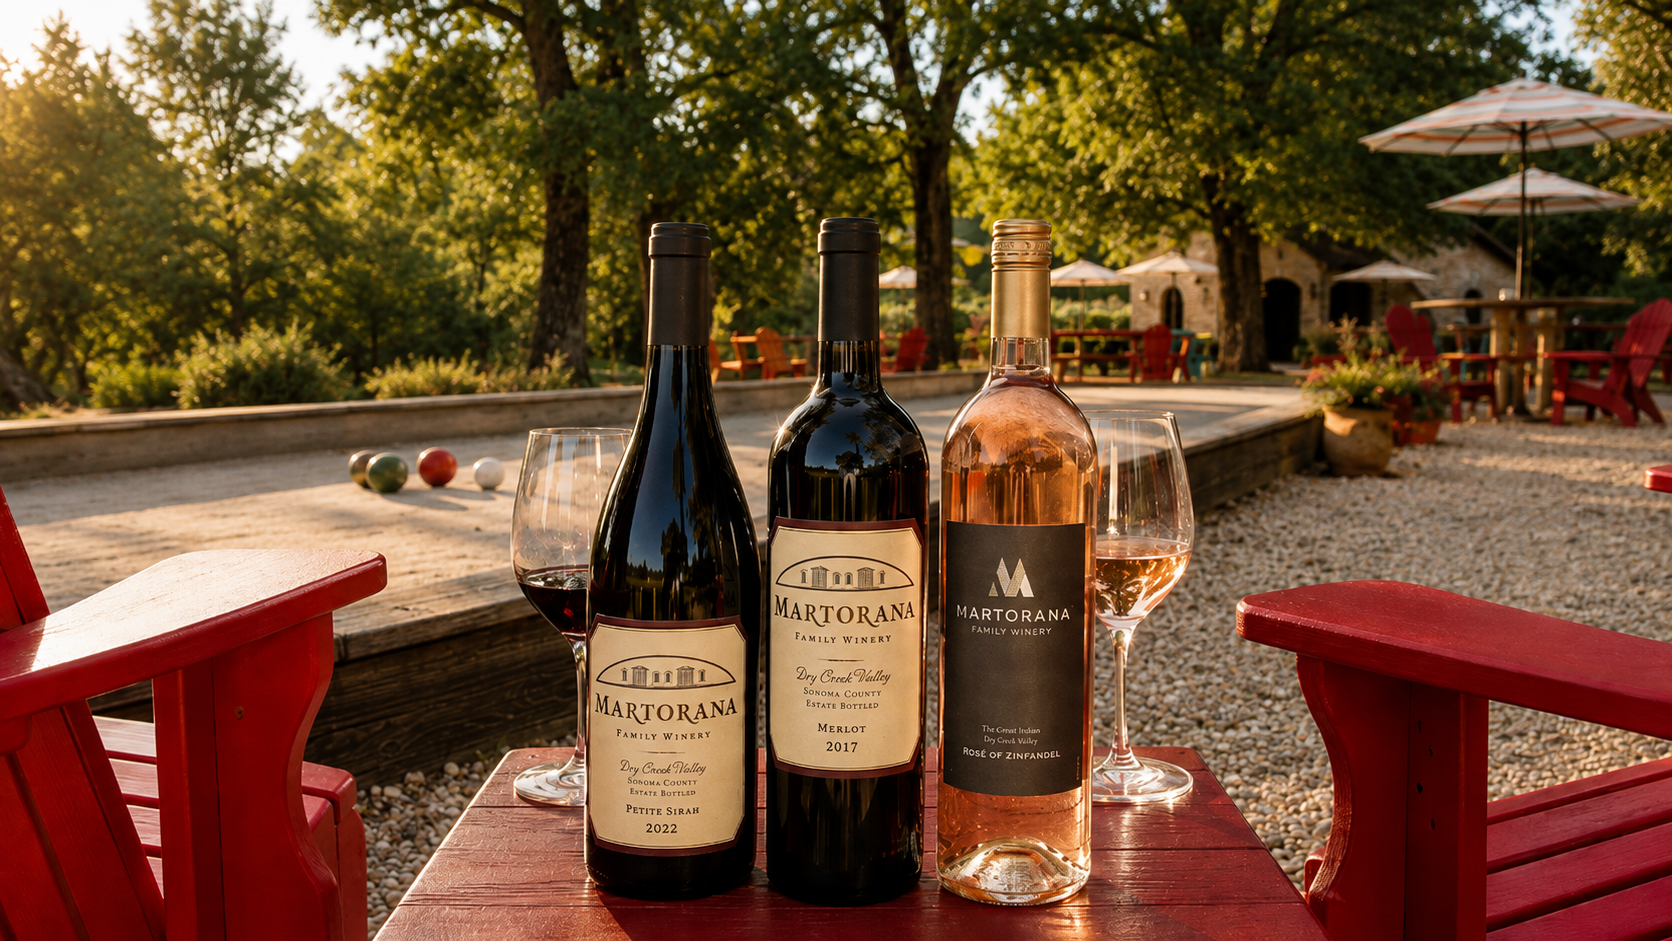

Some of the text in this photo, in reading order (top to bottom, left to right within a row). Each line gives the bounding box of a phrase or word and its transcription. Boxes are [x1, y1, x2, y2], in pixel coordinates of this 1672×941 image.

[774, 594, 915, 628] MARTORANA
[956, 604, 1070, 623] MARTORANA
[971, 625, 1052, 636] FAMILY WINERY
[795, 632, 892, 644] FAMILY WINERY
[796, 666, 891, 686] Dry Creek Valley
[803, 687, 882, 698] SONOMA COUNTY
[595, 693, 738, 725] MARTORANA
[806, 699, 879, 710] ESTATE BOTTLED
[817, 723, 867, 733] MERLOT
[982, 724, 995, 733] The
[616, 729, 711, 741] FAMILY WINERY
[984, 735, 996, 745] Dry
[826, 741, 858, 753] 2017
[963, 746, 1061, 760] ROSÉ OF ZINFANDEL
[663, 779, 697, 787] COUNTY
[629, 788, 657, 796] ESTATE
[626, 804, 700, 816] PETITE SIRAH
[646, 823, 677, 834] 2022
